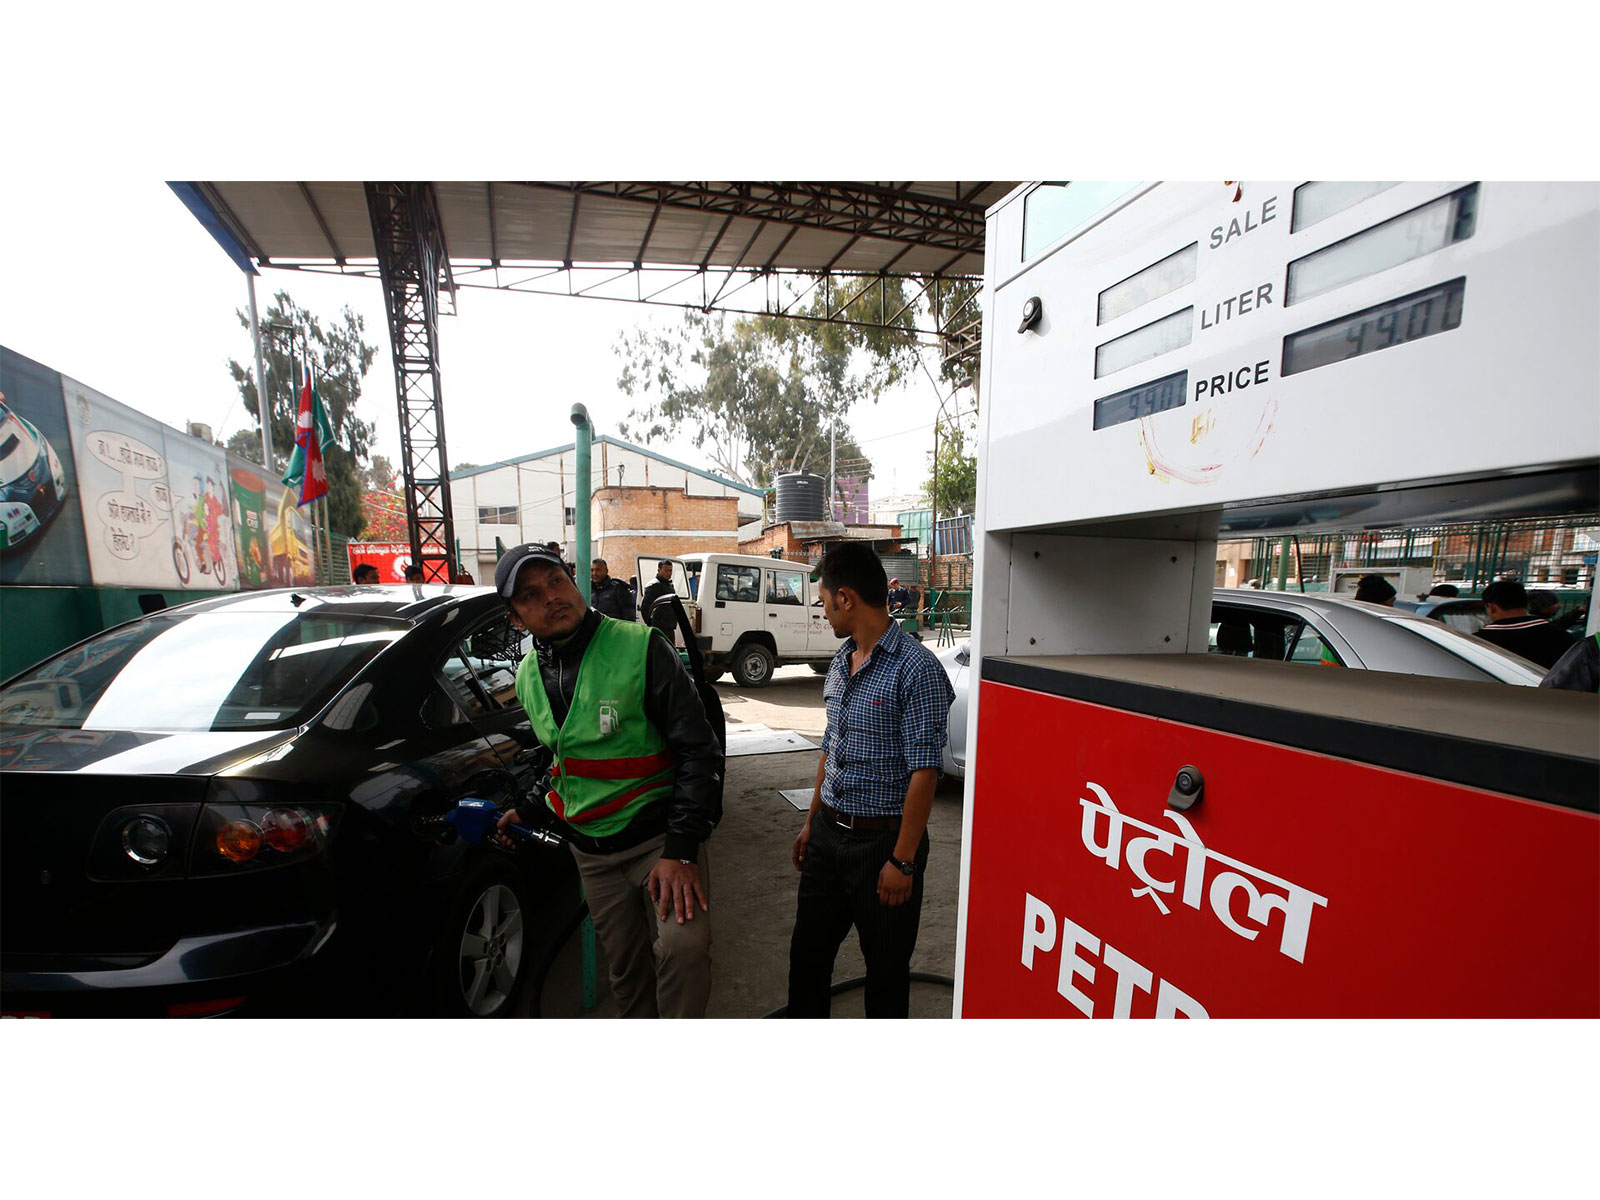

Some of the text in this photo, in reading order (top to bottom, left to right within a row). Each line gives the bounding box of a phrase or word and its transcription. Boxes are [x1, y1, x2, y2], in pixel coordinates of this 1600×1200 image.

[1209, 195, 1278, 250] SALE
[1200, 282, 1273, 330] LITER
[1194, 359, 1270, 402] PRICE
[1079, 781, 1329, 965] पेट्रोल
